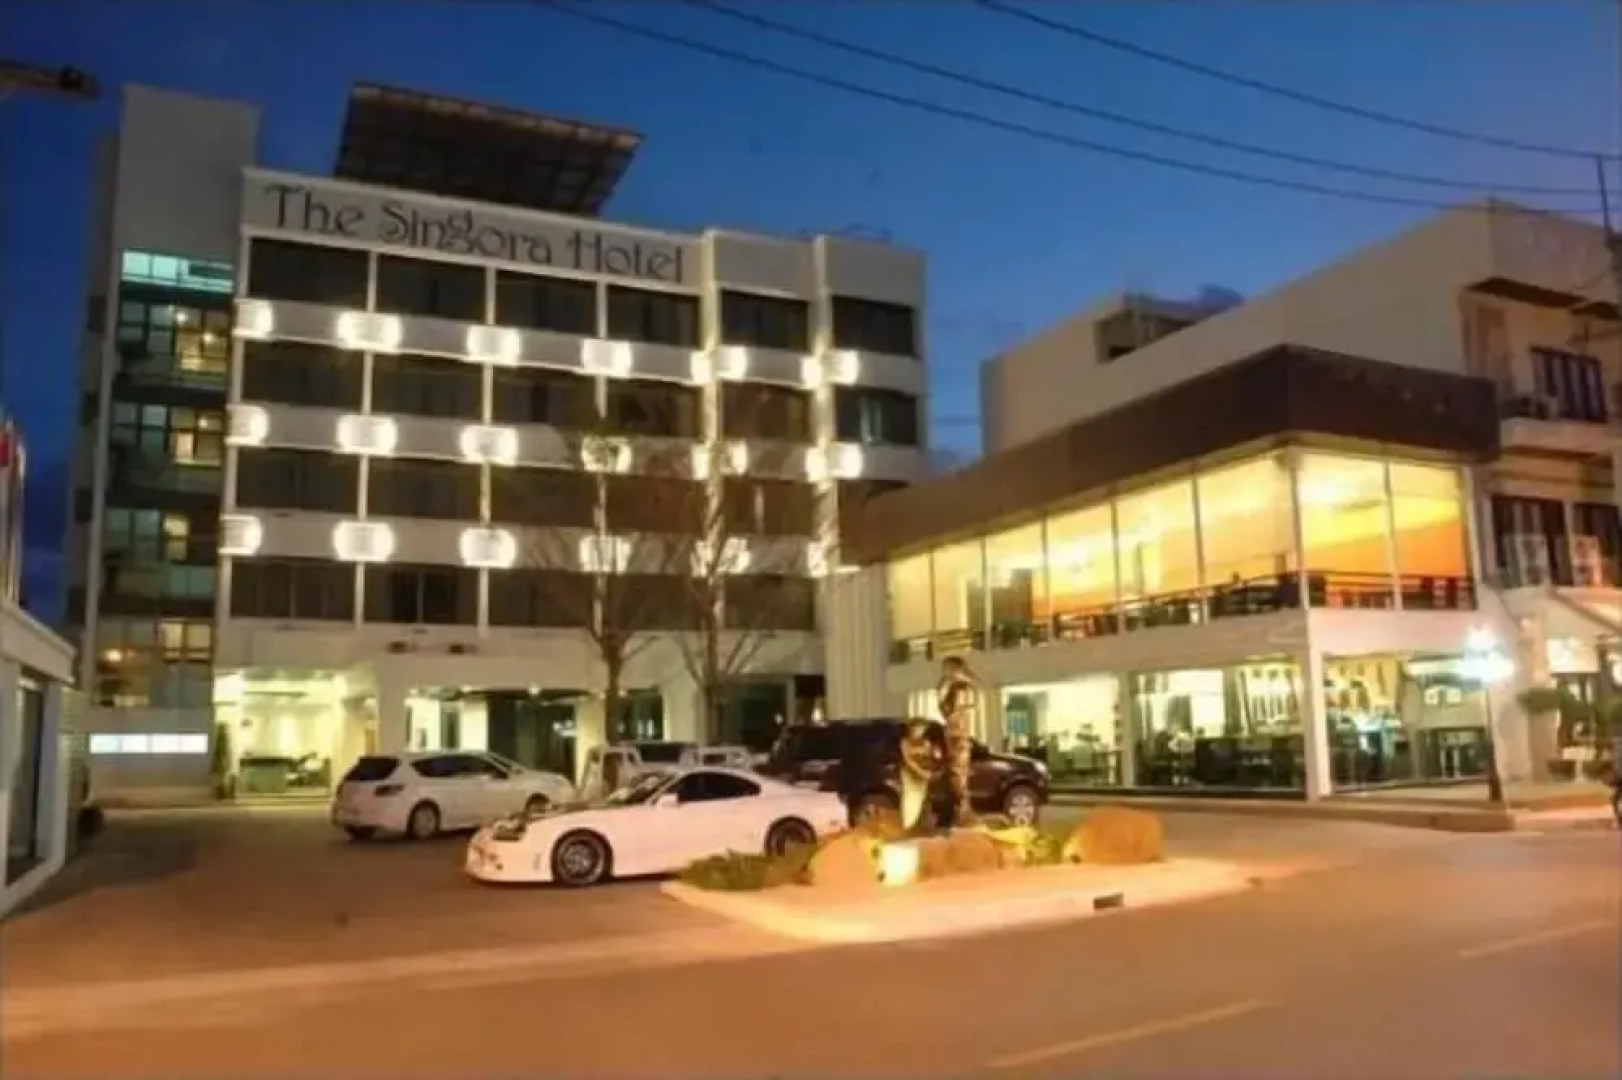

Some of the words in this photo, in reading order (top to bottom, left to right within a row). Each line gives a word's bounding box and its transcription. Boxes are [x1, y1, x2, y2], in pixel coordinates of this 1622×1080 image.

[266, 184, 364, 235] The
[378, 201, 553, 266] Singora
[566, 228, 686, 284] Hotel
